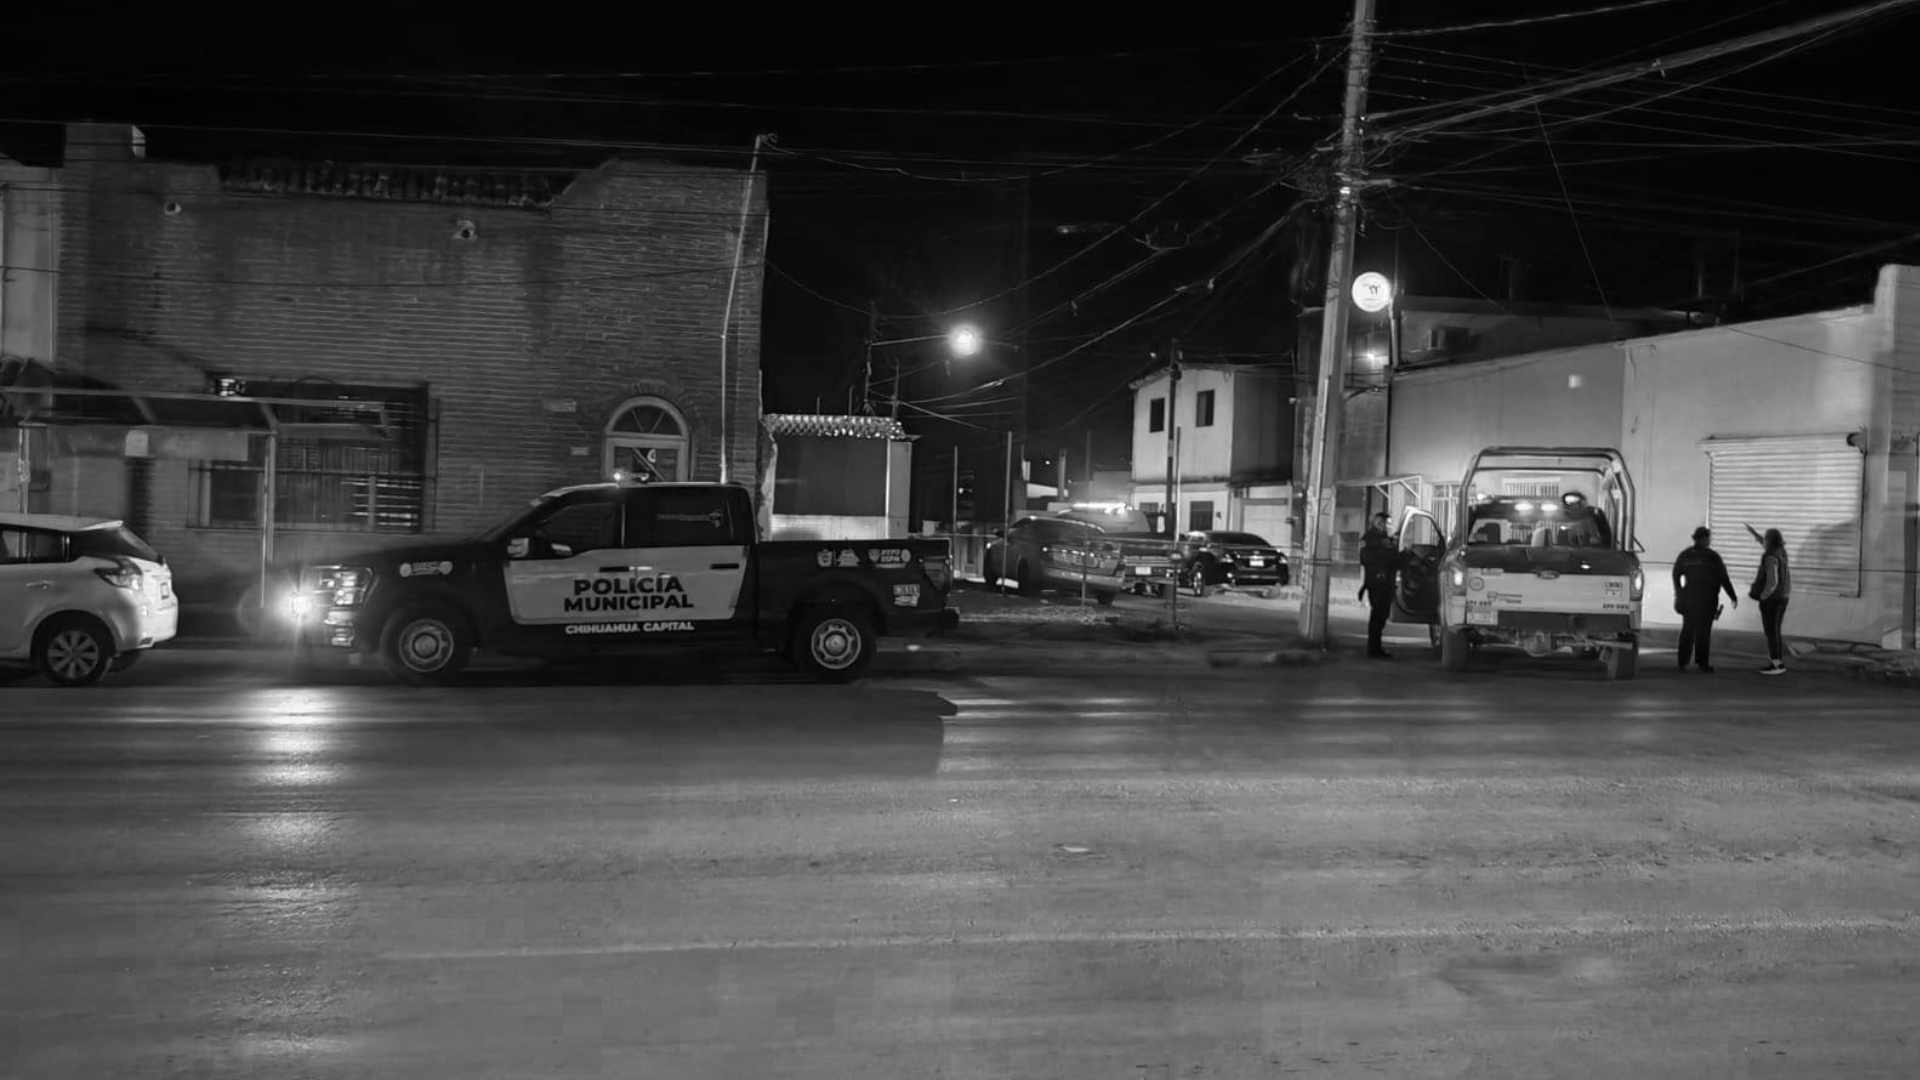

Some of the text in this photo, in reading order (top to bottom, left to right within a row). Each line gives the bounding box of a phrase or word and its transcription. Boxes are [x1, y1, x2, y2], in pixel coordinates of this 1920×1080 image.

[564, 594, 694, 612] MUNICIPAL
[565, 621, 695, 635] CHIHUAHUA CAPITAL
